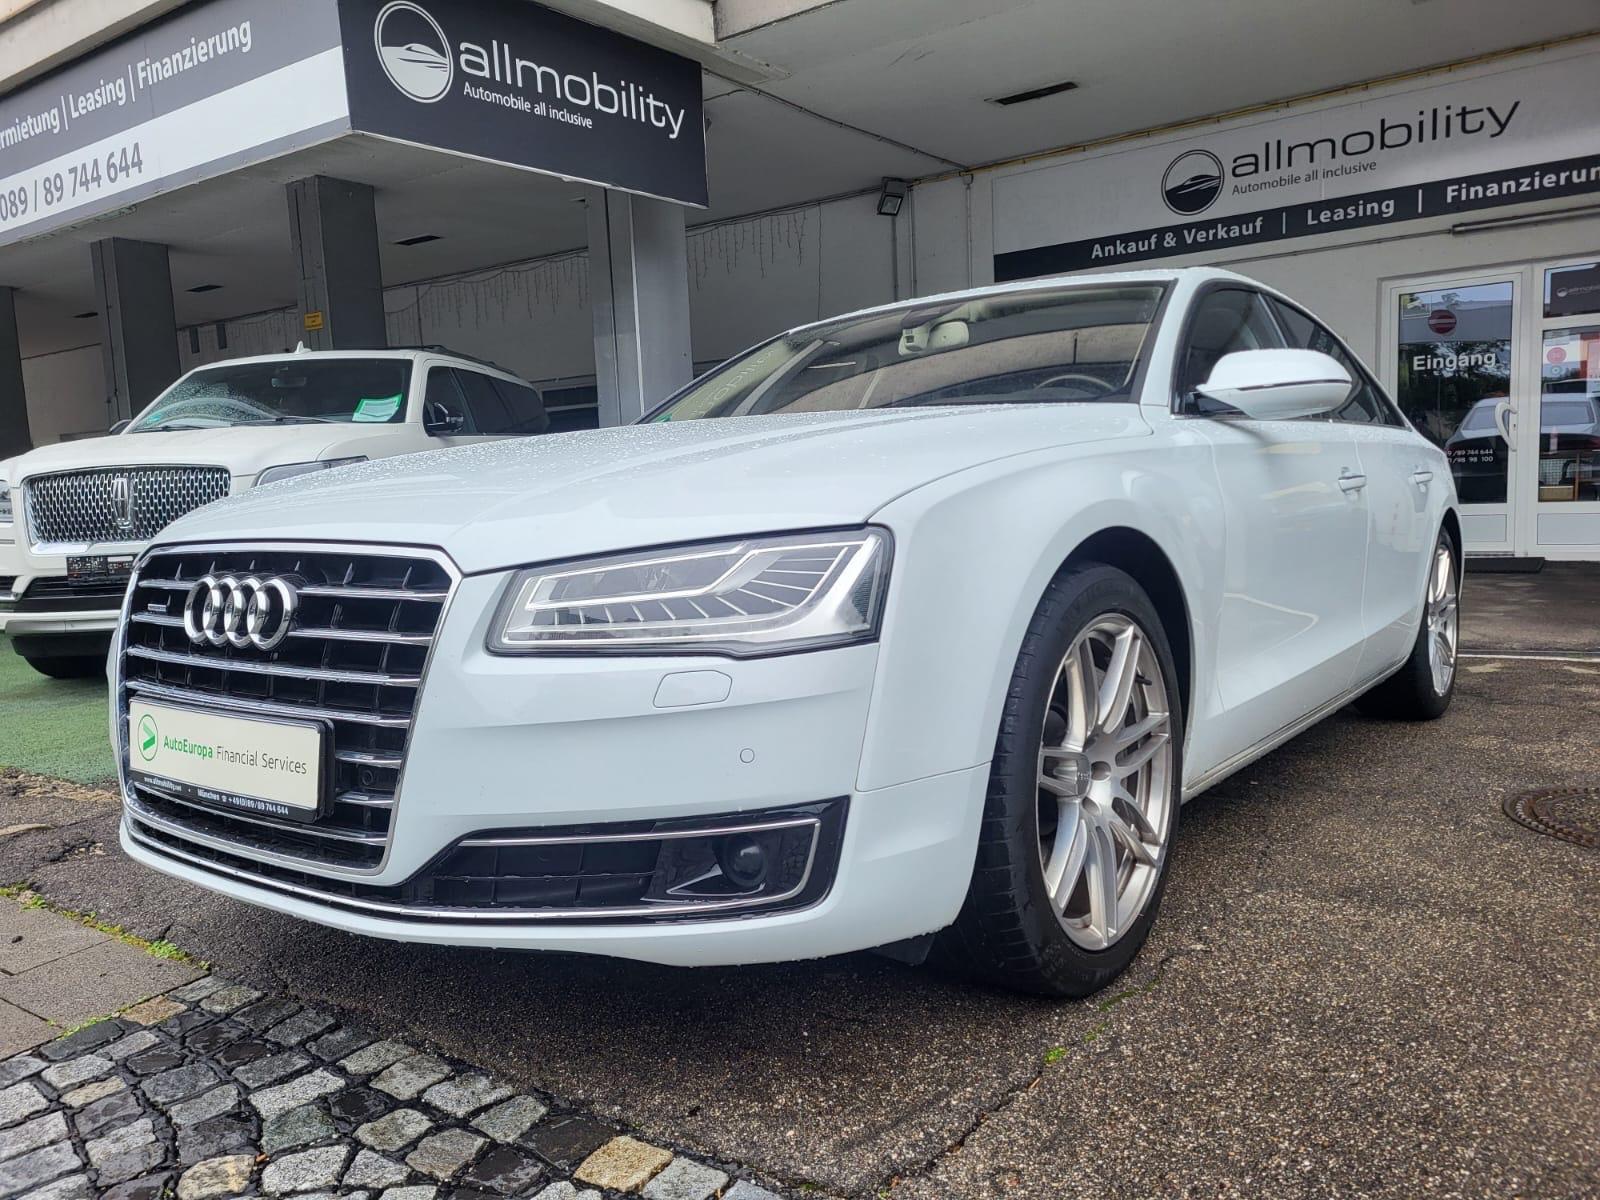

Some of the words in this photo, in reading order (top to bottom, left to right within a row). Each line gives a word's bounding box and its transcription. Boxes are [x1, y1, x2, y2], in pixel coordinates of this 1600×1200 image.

[0, 106, 60, 151] rmietung
[69, 75, 126, 119] Leasing
[137, 20, 252, 89] Finanzierung
[459, 40, 685, 139] allmobility
[463, 81, 532, 113] Automobile
[534, 102, 547, 117] all
[549, 104, 593, 129] inclusive
[1231, 100, 1520, 178] allmobility
[0, 186, 28, 221] 089
[43, 172, 64, 206] 89
[68, 157, 102, 198] 744
[106, 142, 143, 184] 644
[1232, 173, 1301, 196] Automobile
[1304, 169, 1319, 182] all
[1322, 160, 1377, 180] inclusive
[1091, 233, 1158, 260] Ankauf
[1163, 232, 1177, 248] &
[1183, 217, 1263, 246] Verkauf
[1306, 199, 1395, 226] Leasing
[1412, 352, 1496, 372] Eingang
[163, 735, 213, 759] AutoEuropa
[216, 745, 258, 767] Financial
[261, 753, 307, 775] Services
